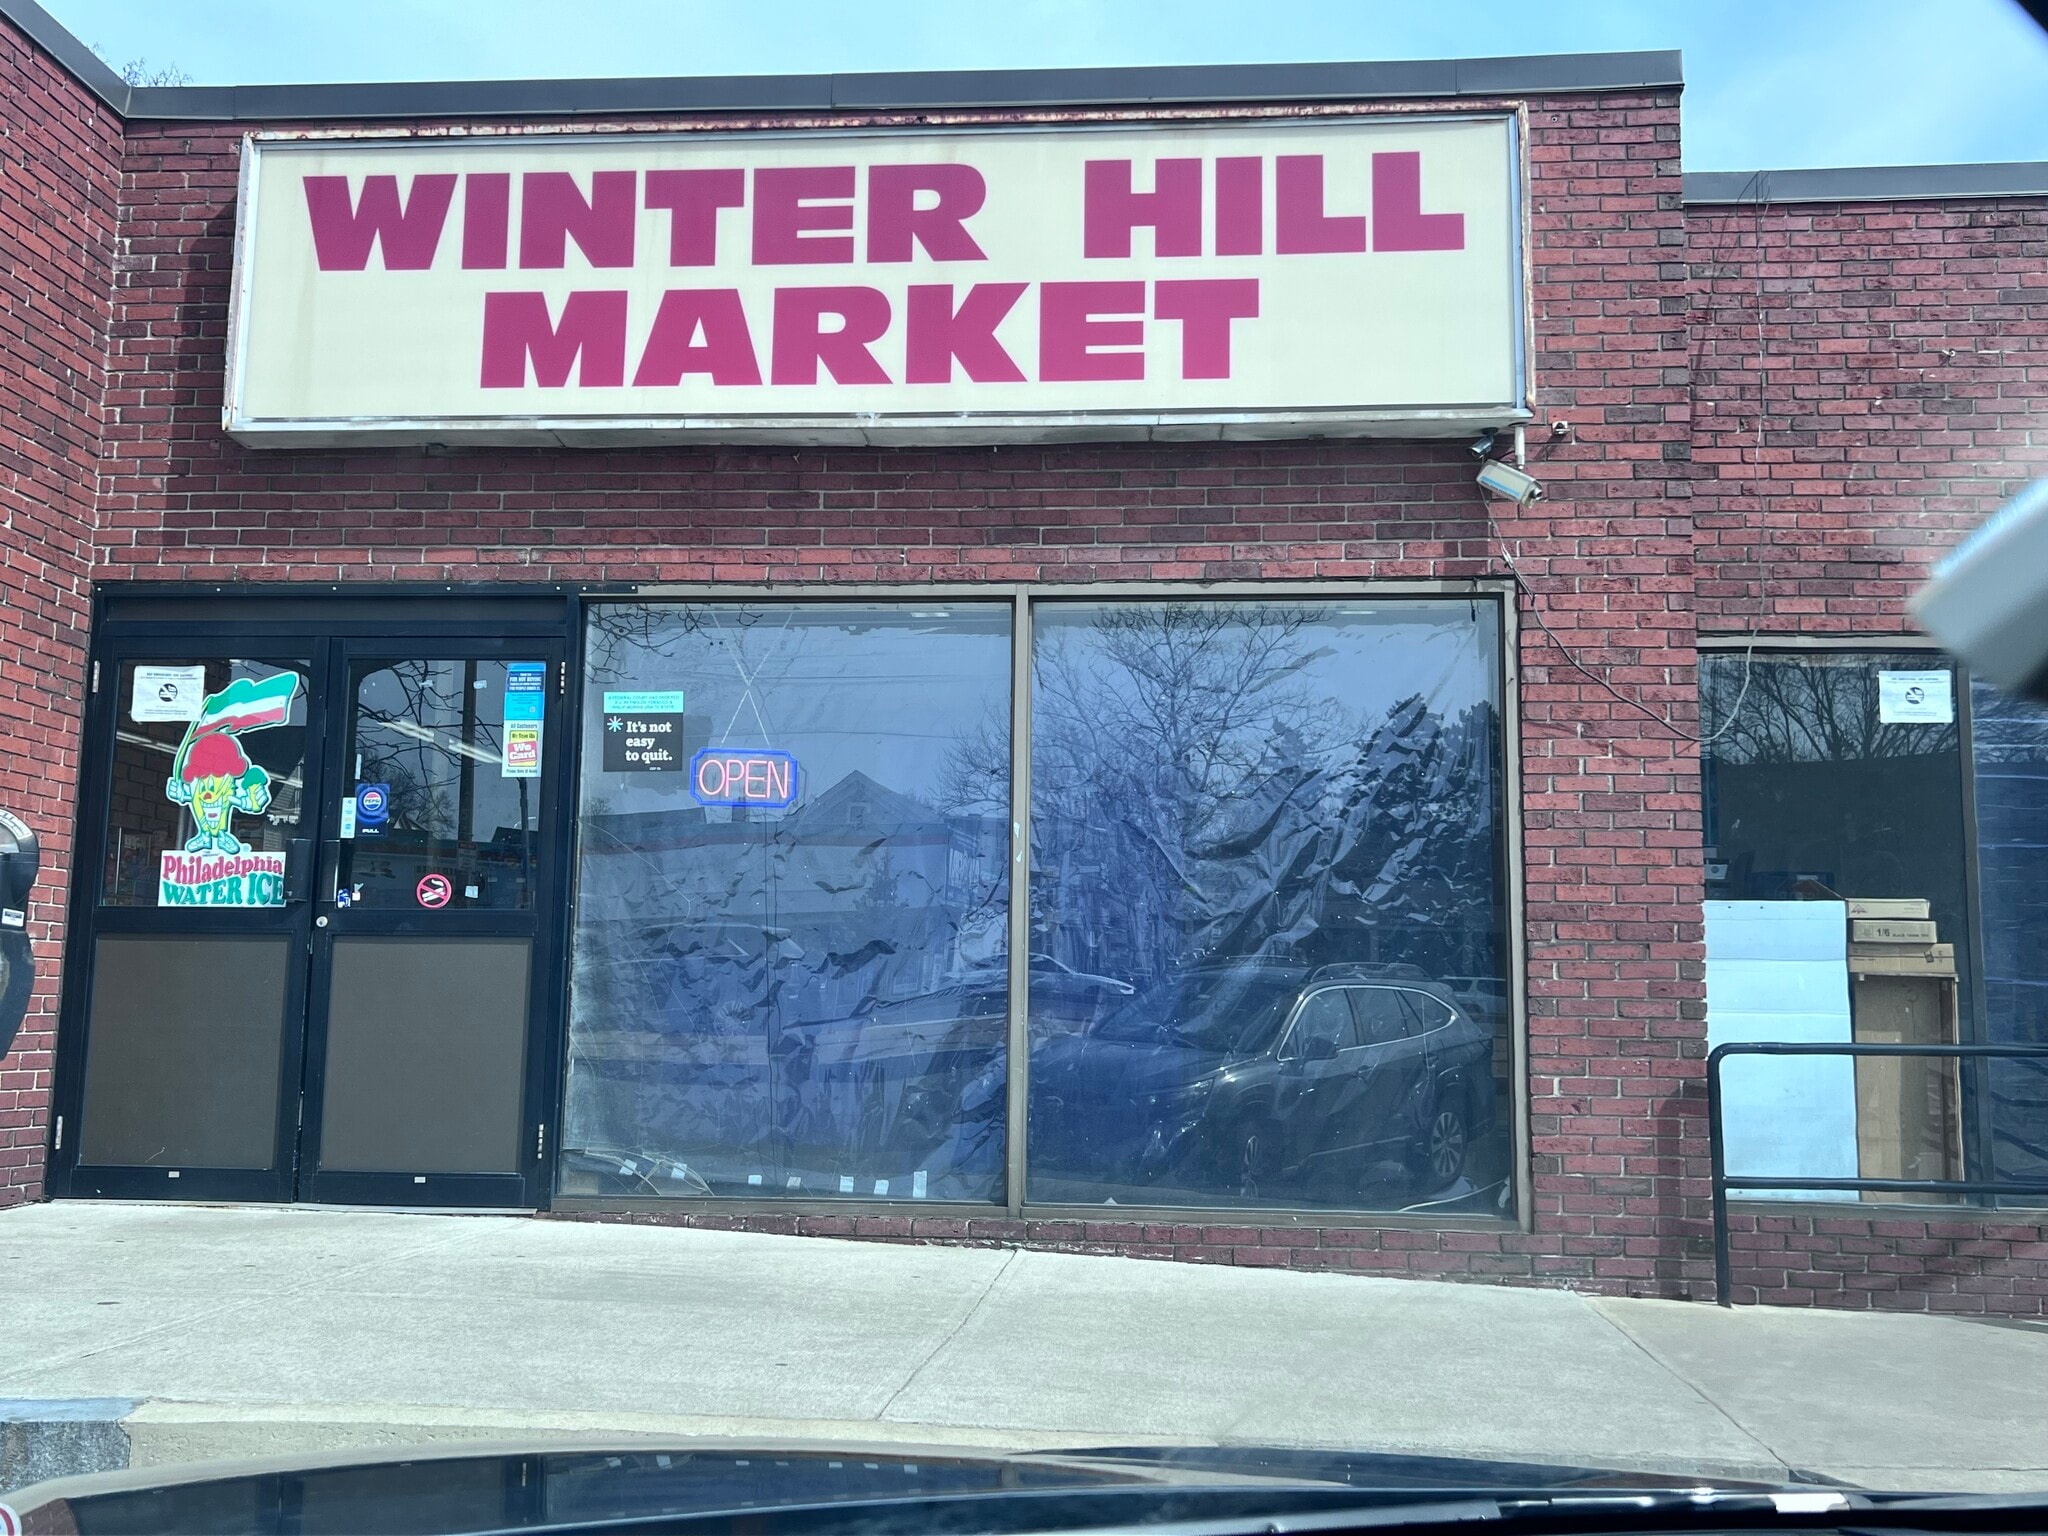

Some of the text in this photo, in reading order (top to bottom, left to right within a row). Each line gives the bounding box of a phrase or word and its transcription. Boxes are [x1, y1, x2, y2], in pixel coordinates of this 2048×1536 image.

[302, 151, 1465, 272] WINTER HILL
[480, 278, 1259, 390] MARKET
[626, 721, 672, 733] It's not
[509, 750, 536, 760] Card
[512, 743, 532, 752] We
[626, 737, 655, 750] easy
[625, 748, 673, 764] to quit.
[698, 759, 789, 799] OPEN
[162, 855, 284, 885] Philadelphia
[162, 872, 285, 905] WATER ICE
